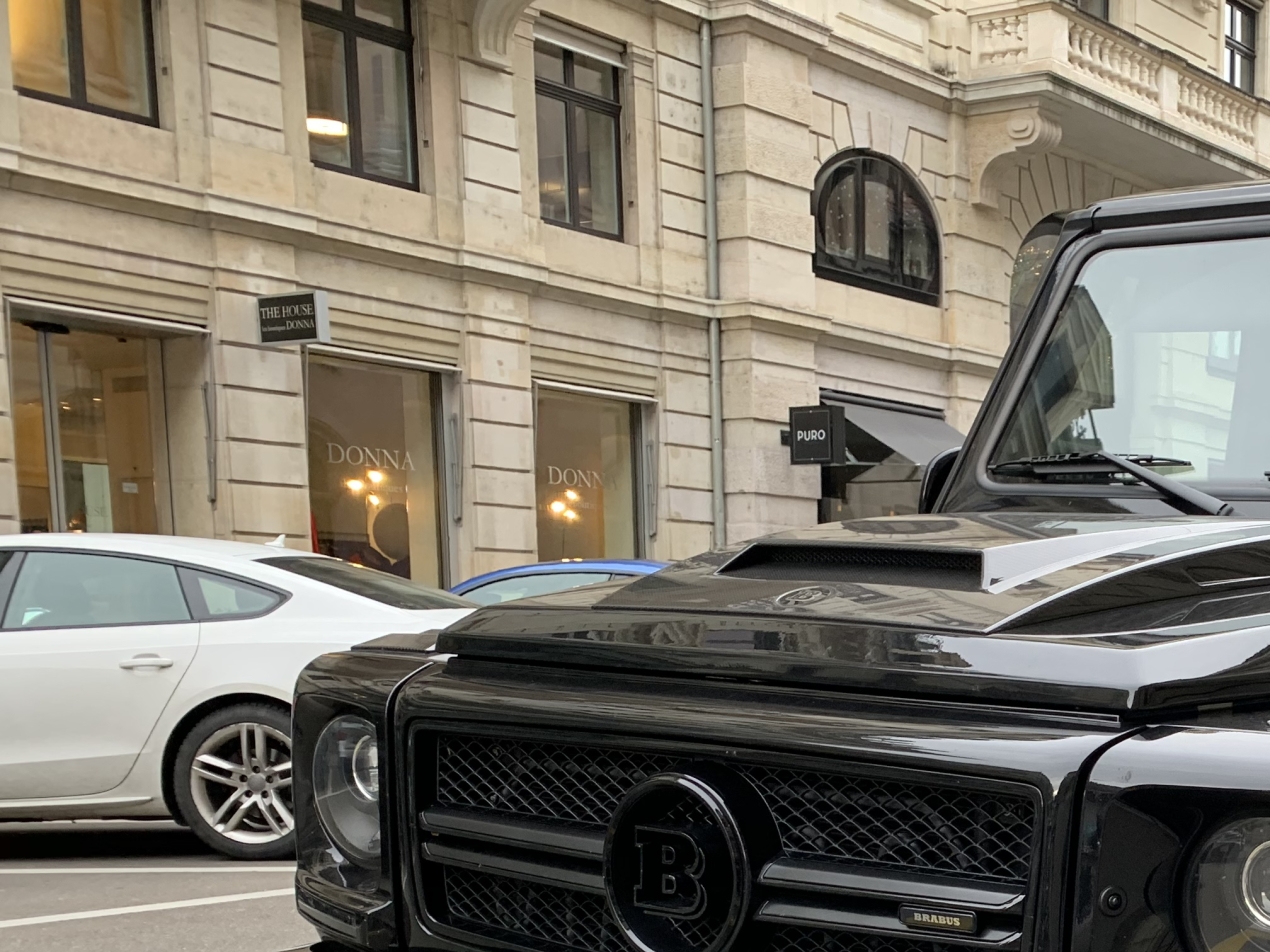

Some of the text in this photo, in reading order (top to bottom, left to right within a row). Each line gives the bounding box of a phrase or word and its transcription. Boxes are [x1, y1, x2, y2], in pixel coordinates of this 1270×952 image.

[260, 304, 314, 319] THE HOUSE
[286, 319, 315, 330] DONNA
[797, 429, 826, 441] PURO
[326, 442, 416, 471] DONNA
[633, 824, 708, 920] B
[913, 912, 960, 926] BRABUS
